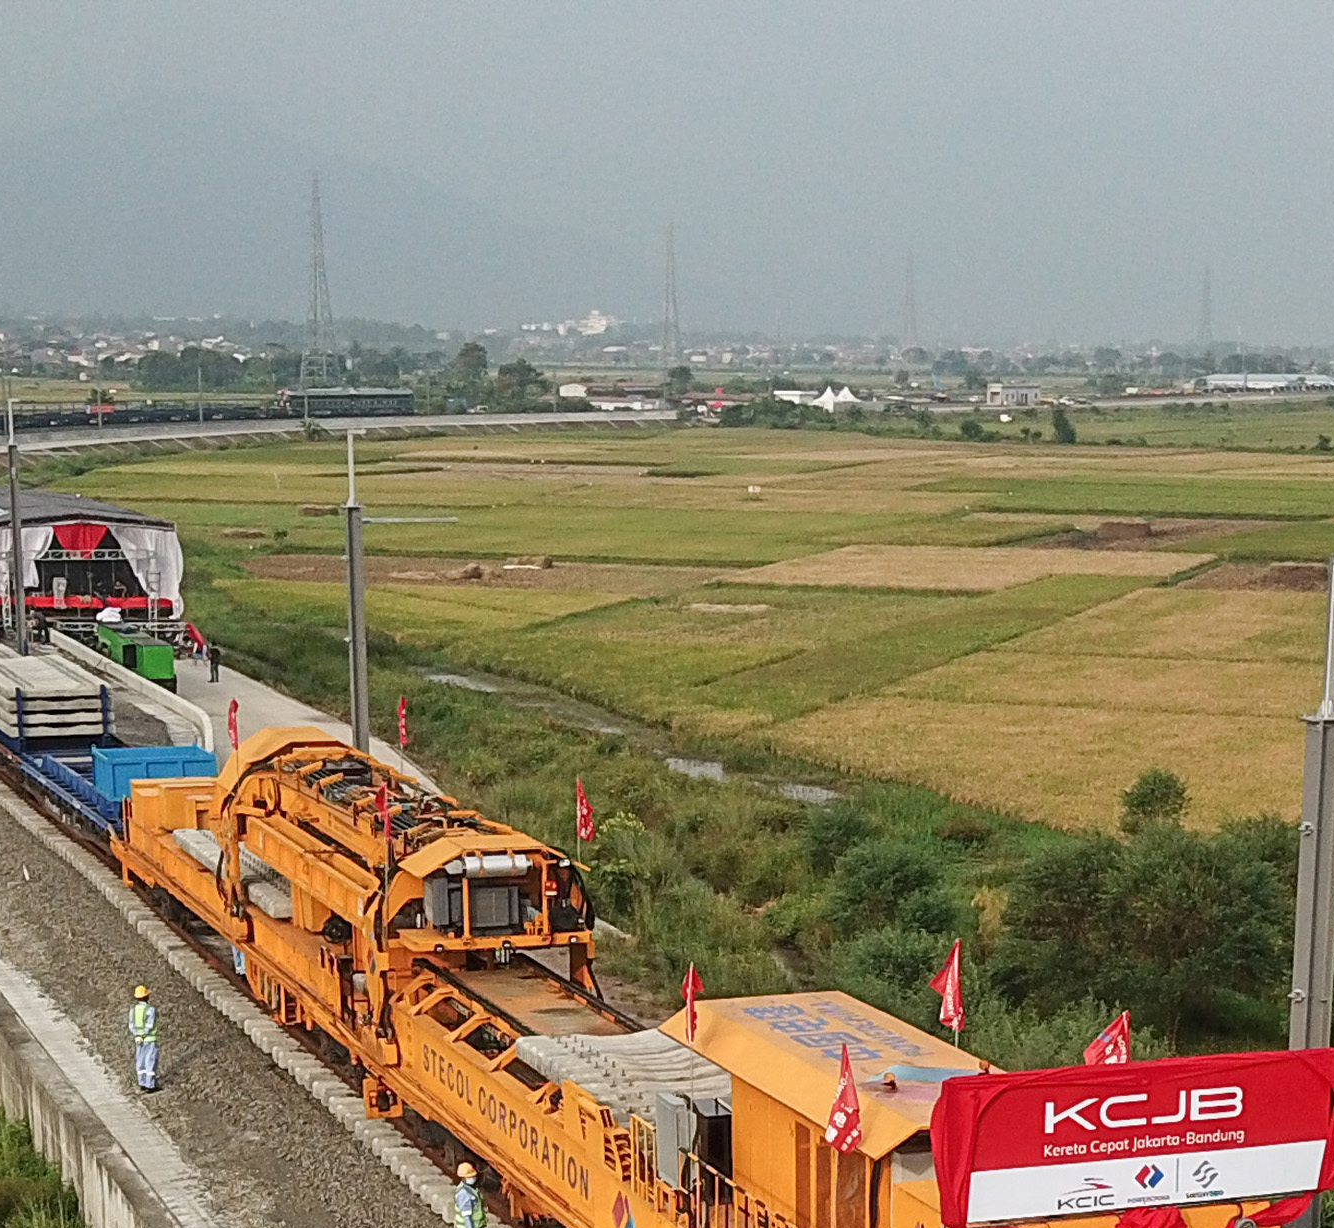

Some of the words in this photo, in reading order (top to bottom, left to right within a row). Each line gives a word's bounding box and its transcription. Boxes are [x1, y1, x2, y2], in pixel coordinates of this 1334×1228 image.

[422, 1043, 474, 1107] STECOL
[477, 1085, 590, 1202] CORPORATION
[1043, 1085, 1244, 1135] KCJB
[1043, 1142, 1087, 1158] Kereta
[1089, 1139, 1130, 1155] Cepat
[1131, 1128, 1246, 1153] Jakarta-Bandung
[1057, 1193, 1116, 1211] KCIC
